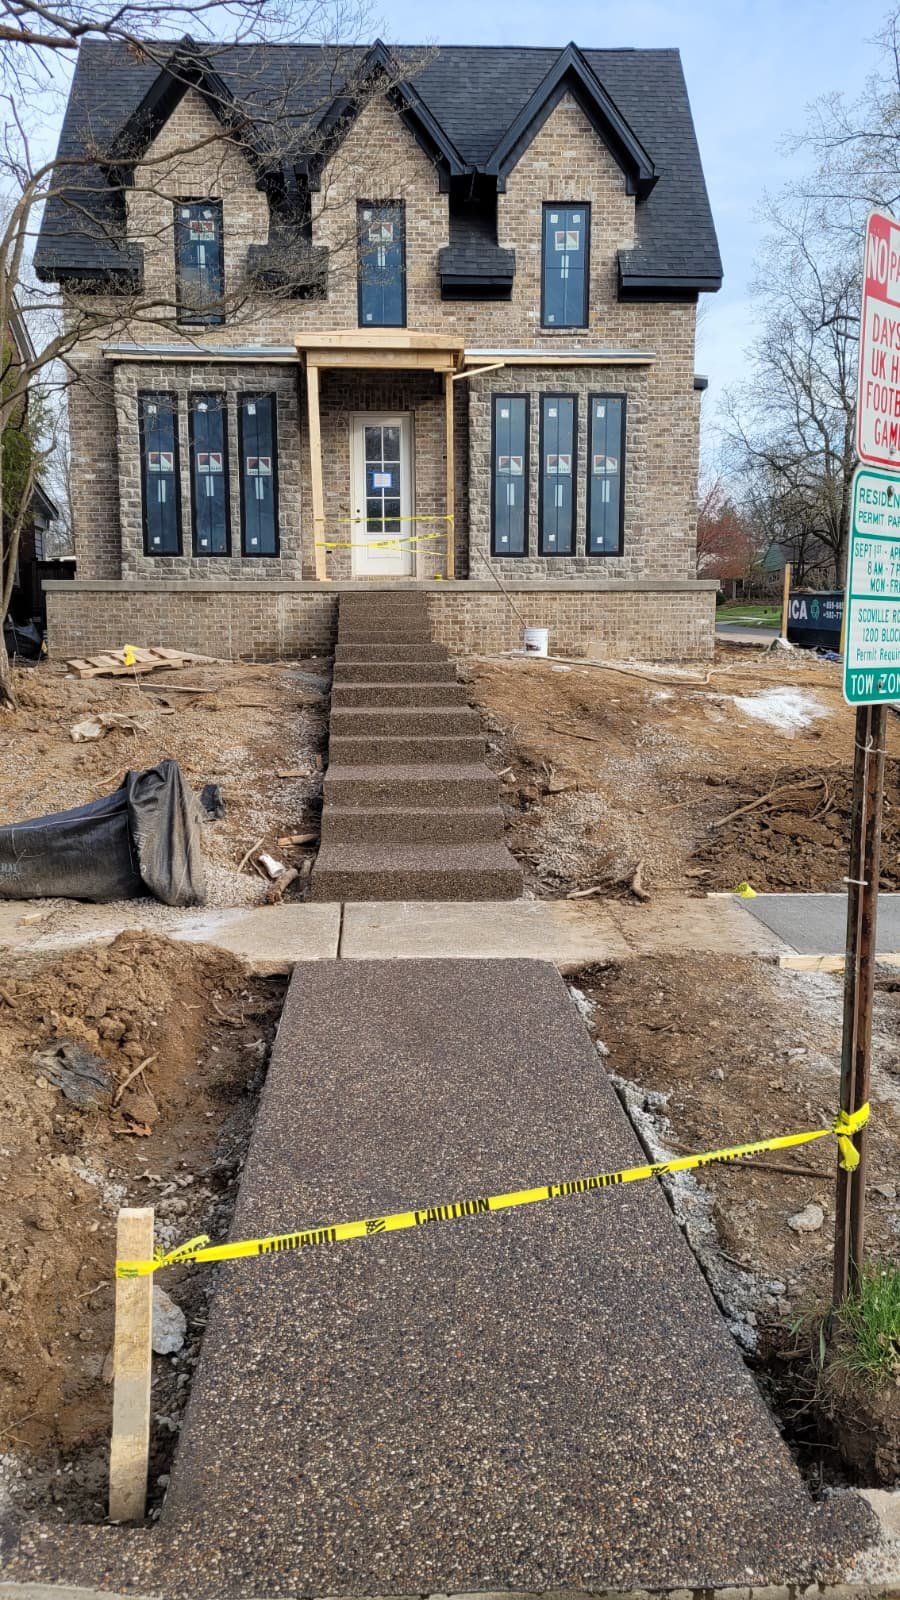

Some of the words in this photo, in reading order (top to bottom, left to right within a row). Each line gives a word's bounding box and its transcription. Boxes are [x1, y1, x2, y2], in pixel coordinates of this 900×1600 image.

[867, 232, 888, 285] NO
[872, 347, 887, 379] UK
[858, 510, 885, 526] PERMIT
[855, 542, 872, 557] SEPT
[867, 560, 872, 575] 8
[874, 562, 883, 576] AM
[890, 562, 895, 577] 7
[870, 578, 885, 593] MON
[858, 608, 889, 623] SCOVILLE
[862, 627, 879, 642] 1200
[856, 648, 877, 661] Permit
[851, 674, 874, 696] TOW
